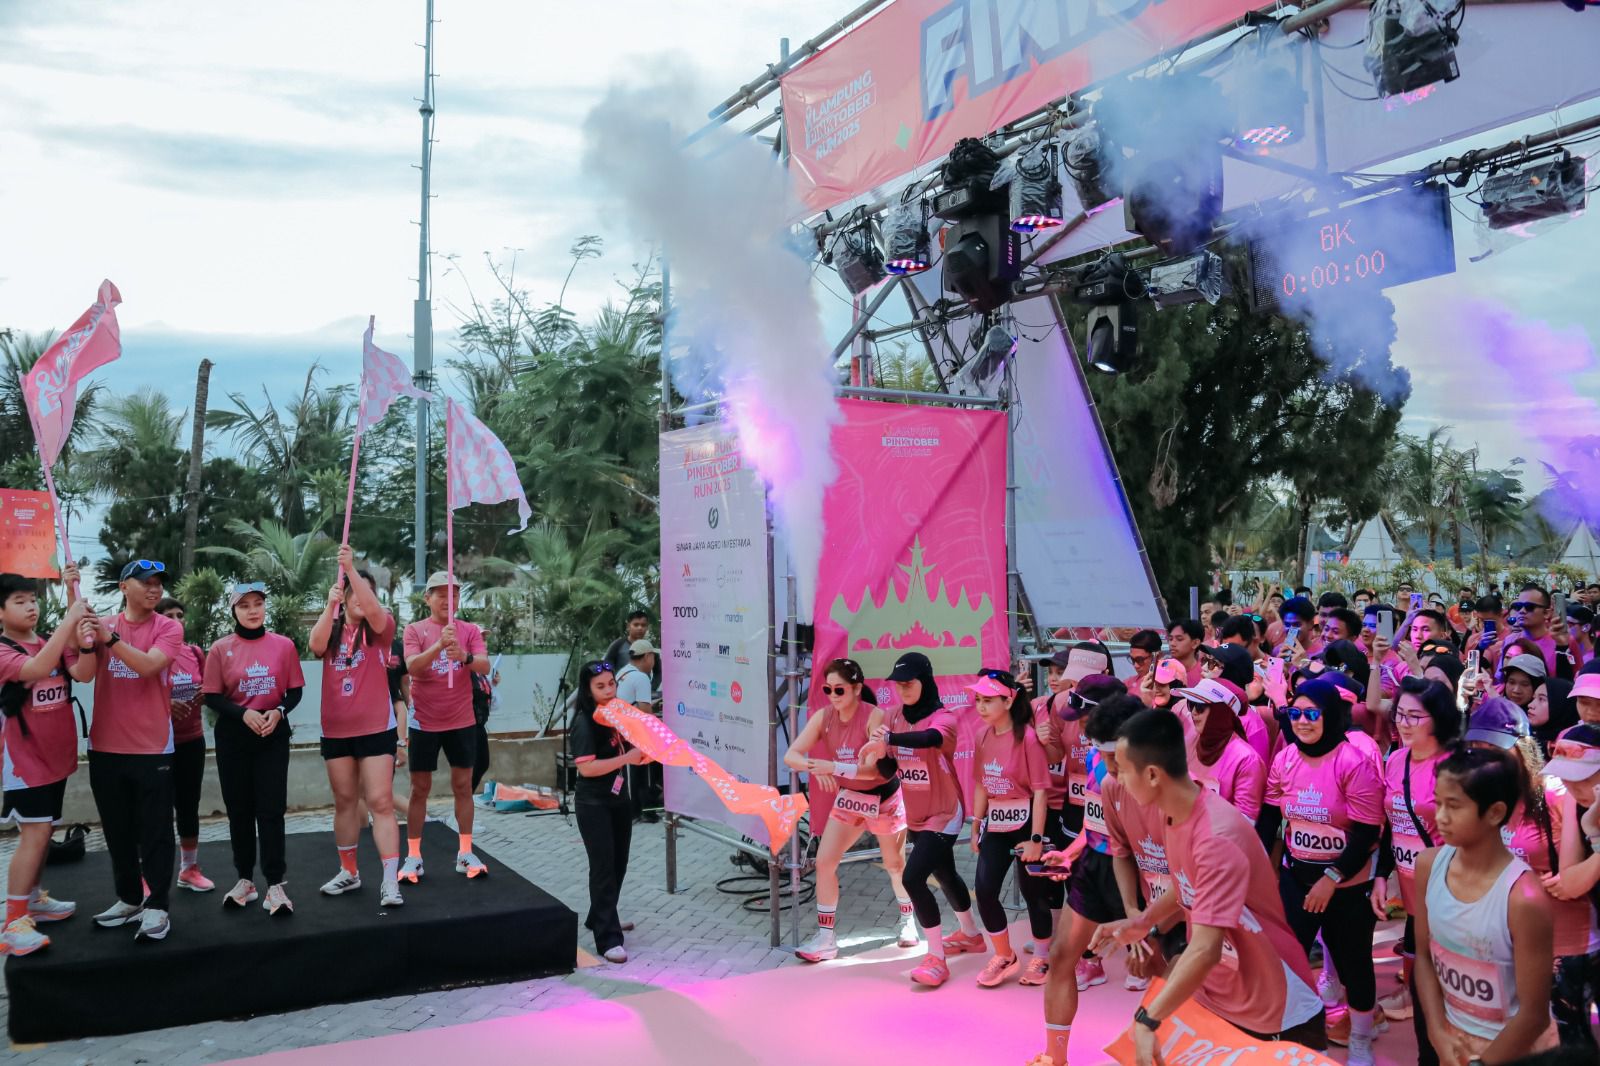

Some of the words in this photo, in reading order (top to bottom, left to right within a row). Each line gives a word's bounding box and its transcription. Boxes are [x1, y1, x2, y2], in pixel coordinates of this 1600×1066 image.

[812, 69, 873, 122] LAMPUNG
[1320, 219, 1356, 252] 6K
[1283, 250, 1385, 296] 0:00:00
[672, 606, 699, 618] TOTO
[837, 797, 877, 814] 60006
[991, 808, 1028, 822] 60483
[1294, 830, 1345, 850] 60200
